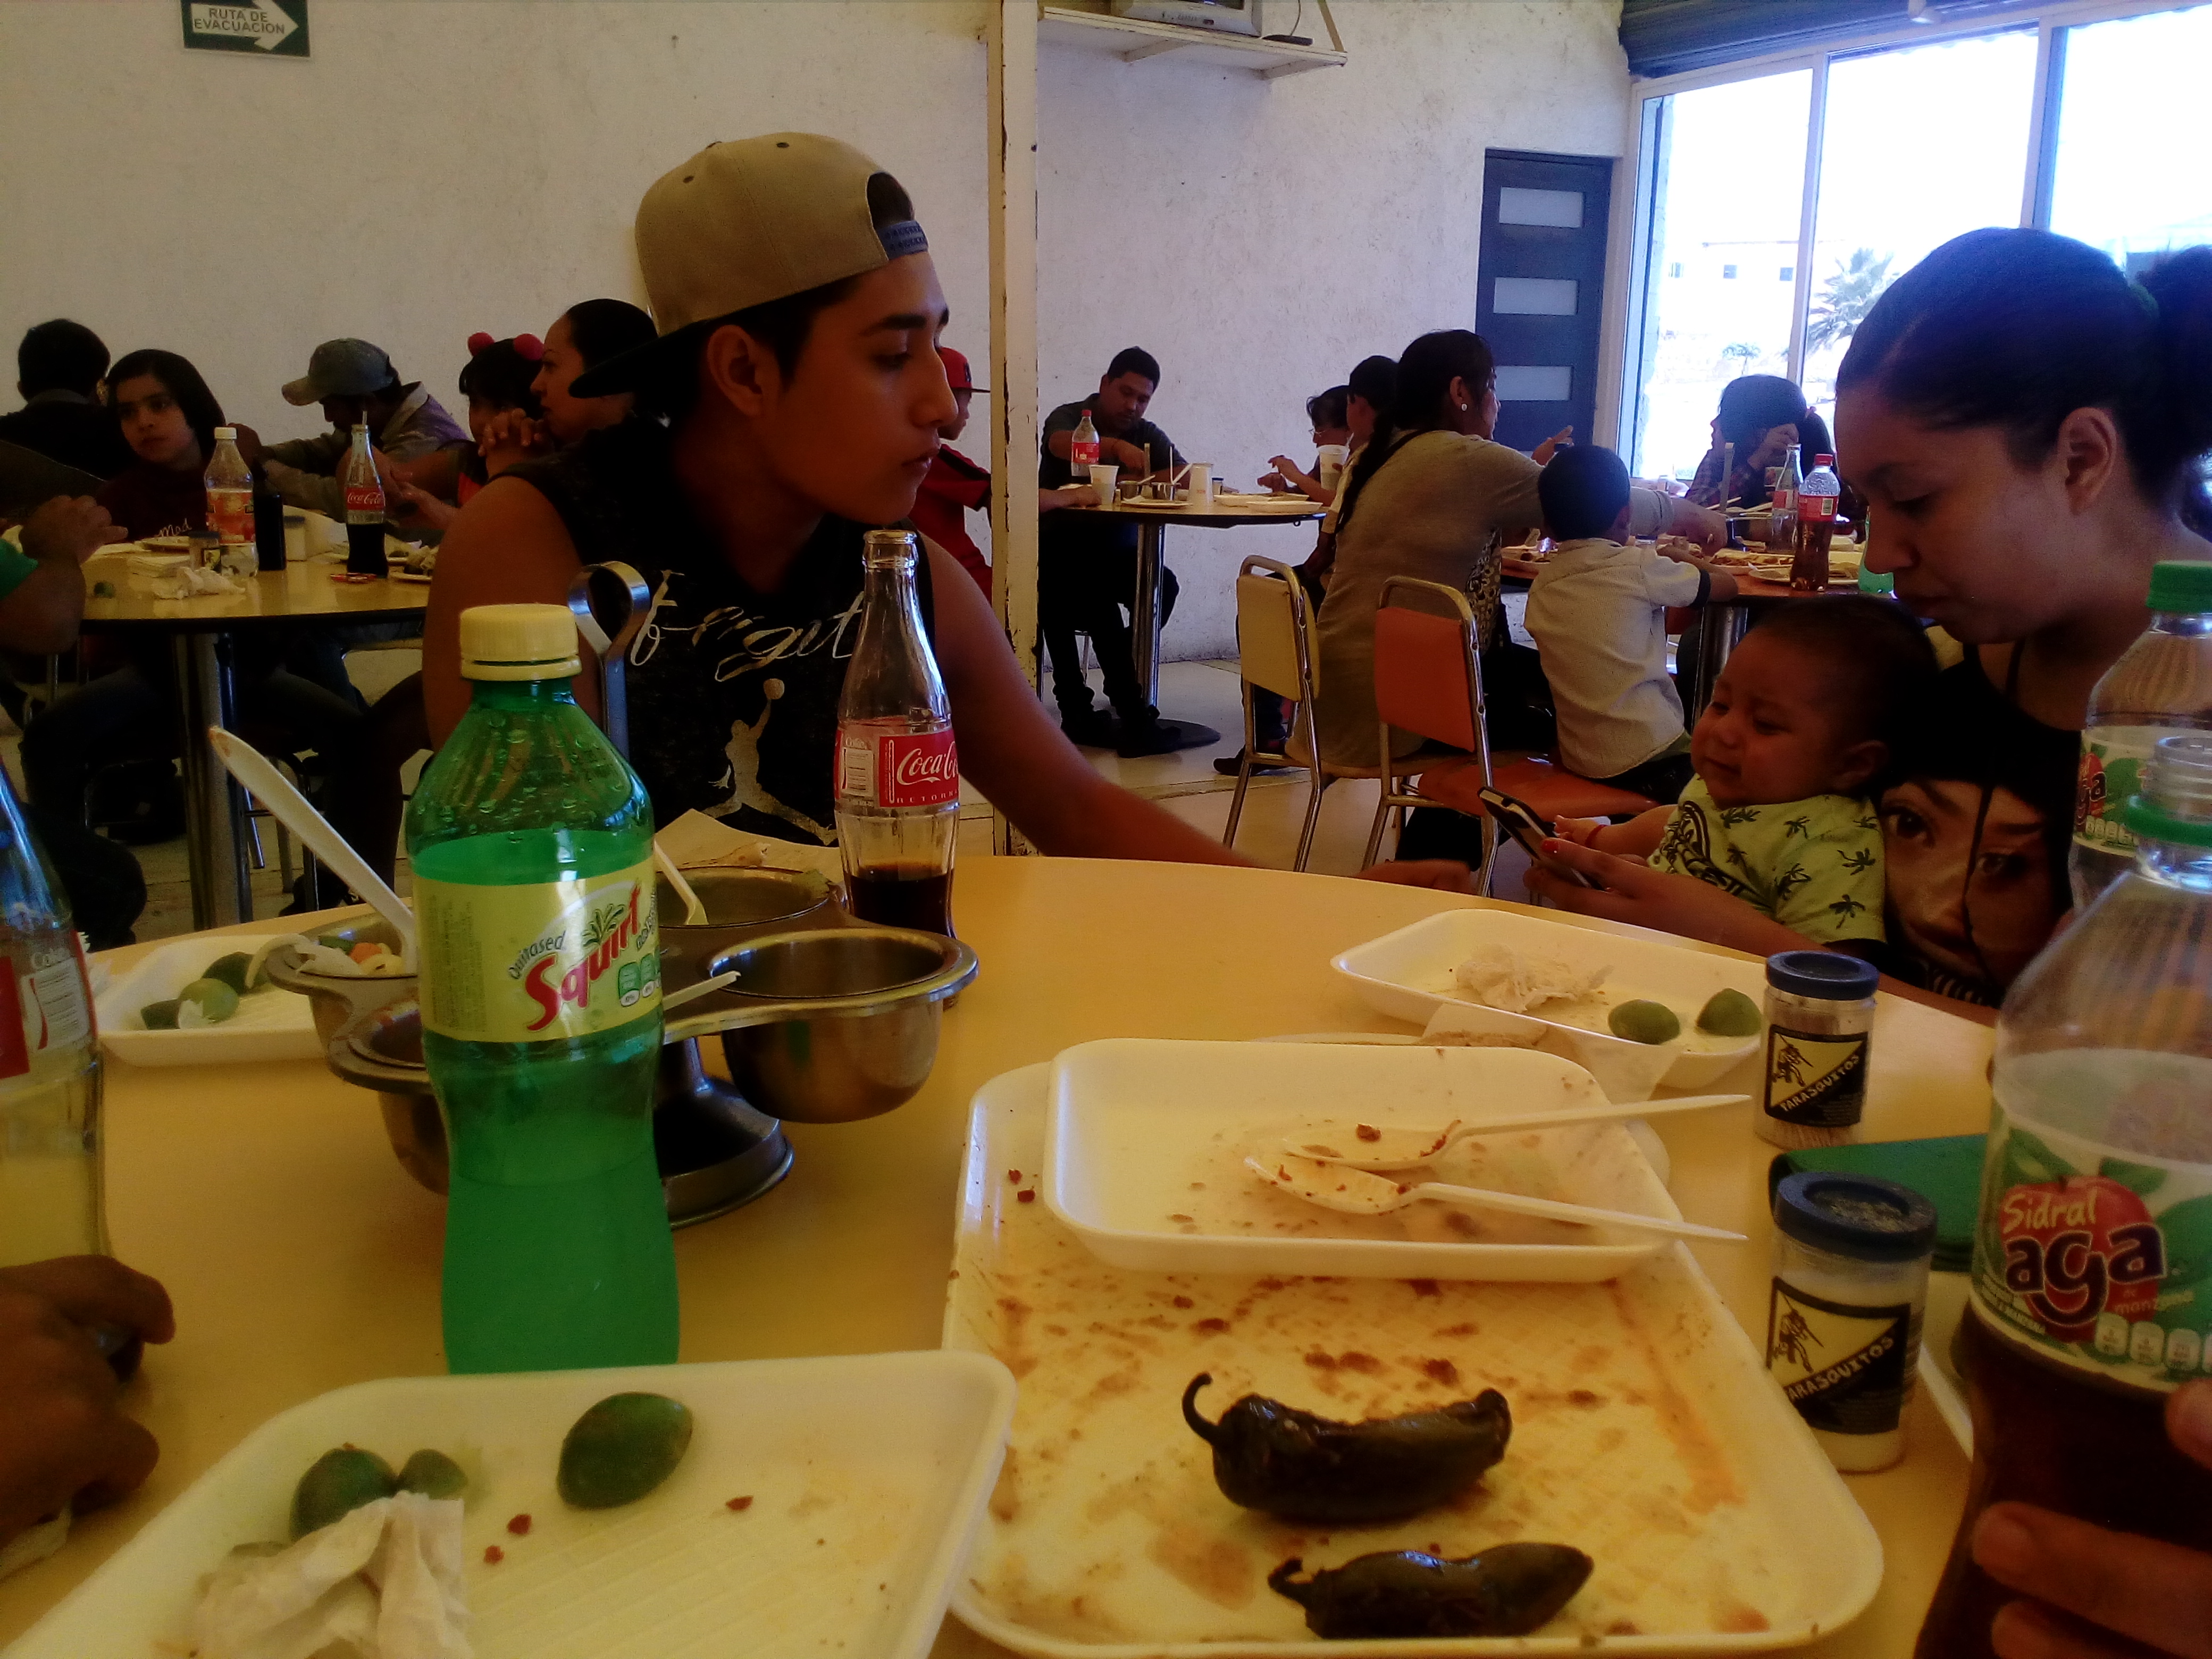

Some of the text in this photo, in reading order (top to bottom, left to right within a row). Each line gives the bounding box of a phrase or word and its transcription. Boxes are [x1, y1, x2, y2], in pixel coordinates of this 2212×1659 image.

[194, 19, 285, 34] EVACUACION
[209, 8, 267, 22] RUTA DE
[2002, 1188, 2098, 1234] Sidral
[2005, 1222, 2168, 1328] aga
[1787, 1336, 1894, 1401] ARASQUITOS
